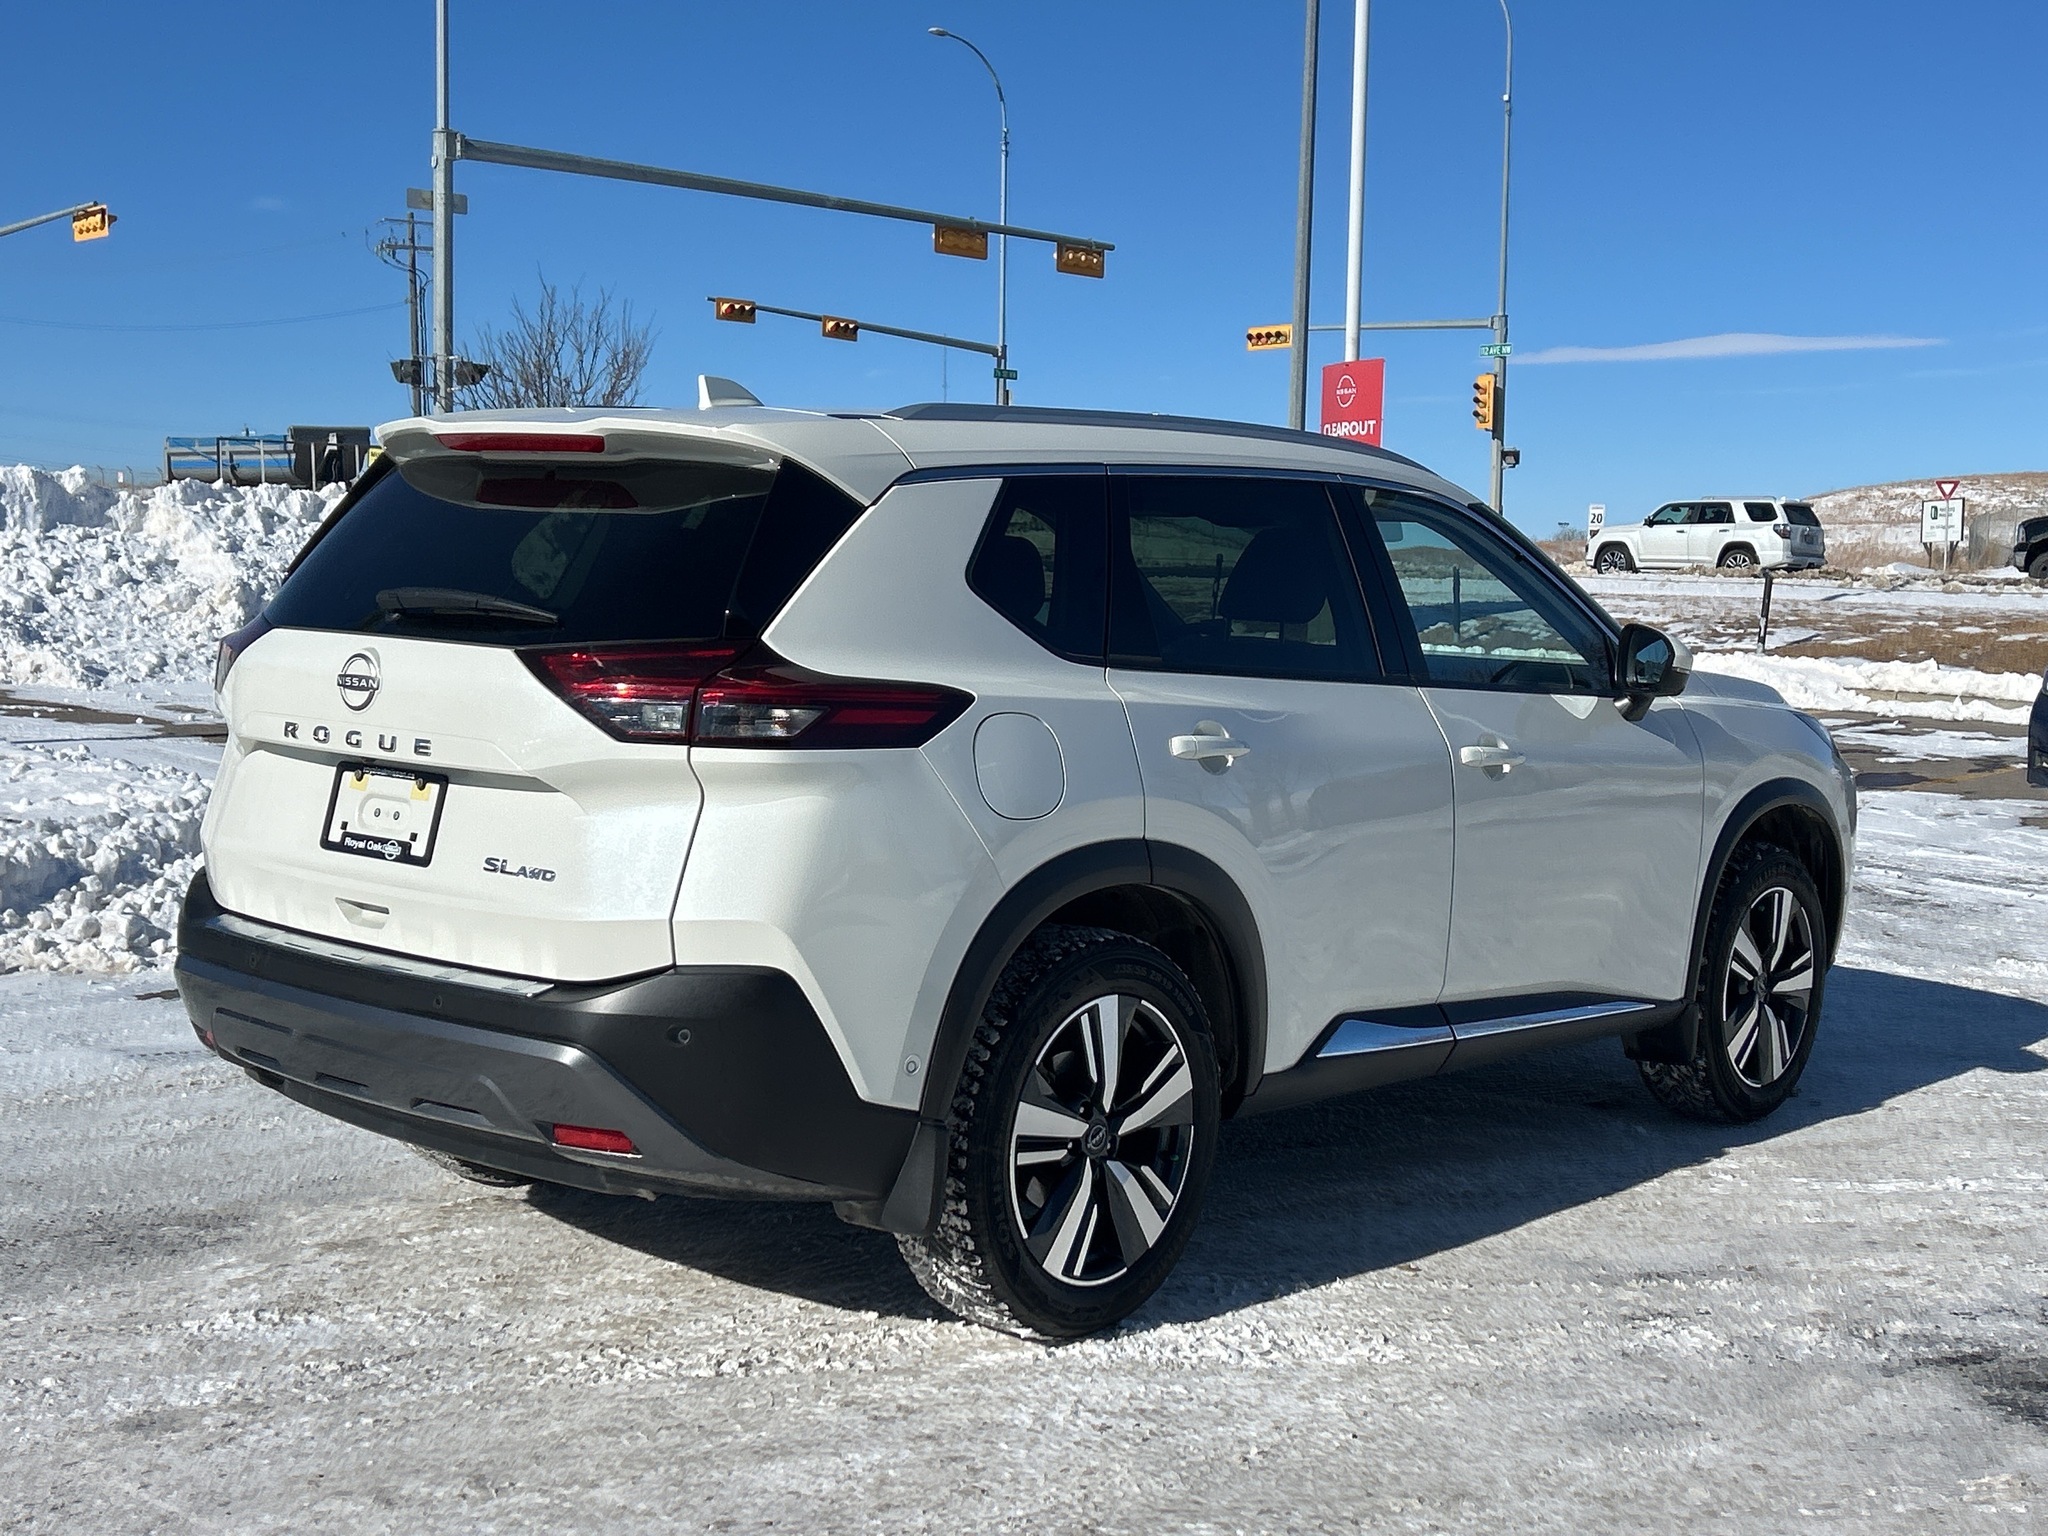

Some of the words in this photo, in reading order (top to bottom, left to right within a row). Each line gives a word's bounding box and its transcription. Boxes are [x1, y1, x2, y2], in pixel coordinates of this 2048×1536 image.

[1490, 346, 1501, 355] AVE
[1323, 420, 1376, 437] CLEAROUT
[1590, 512, 1603, 524] 20
[338, 675, 379, 689] NISSAN
[284, 721, 432, 757] ROGUE
[344, 837, 367, 850] Royal
[483, 857, 517, 876] SL
[516, 865, 557, 883] AWD
